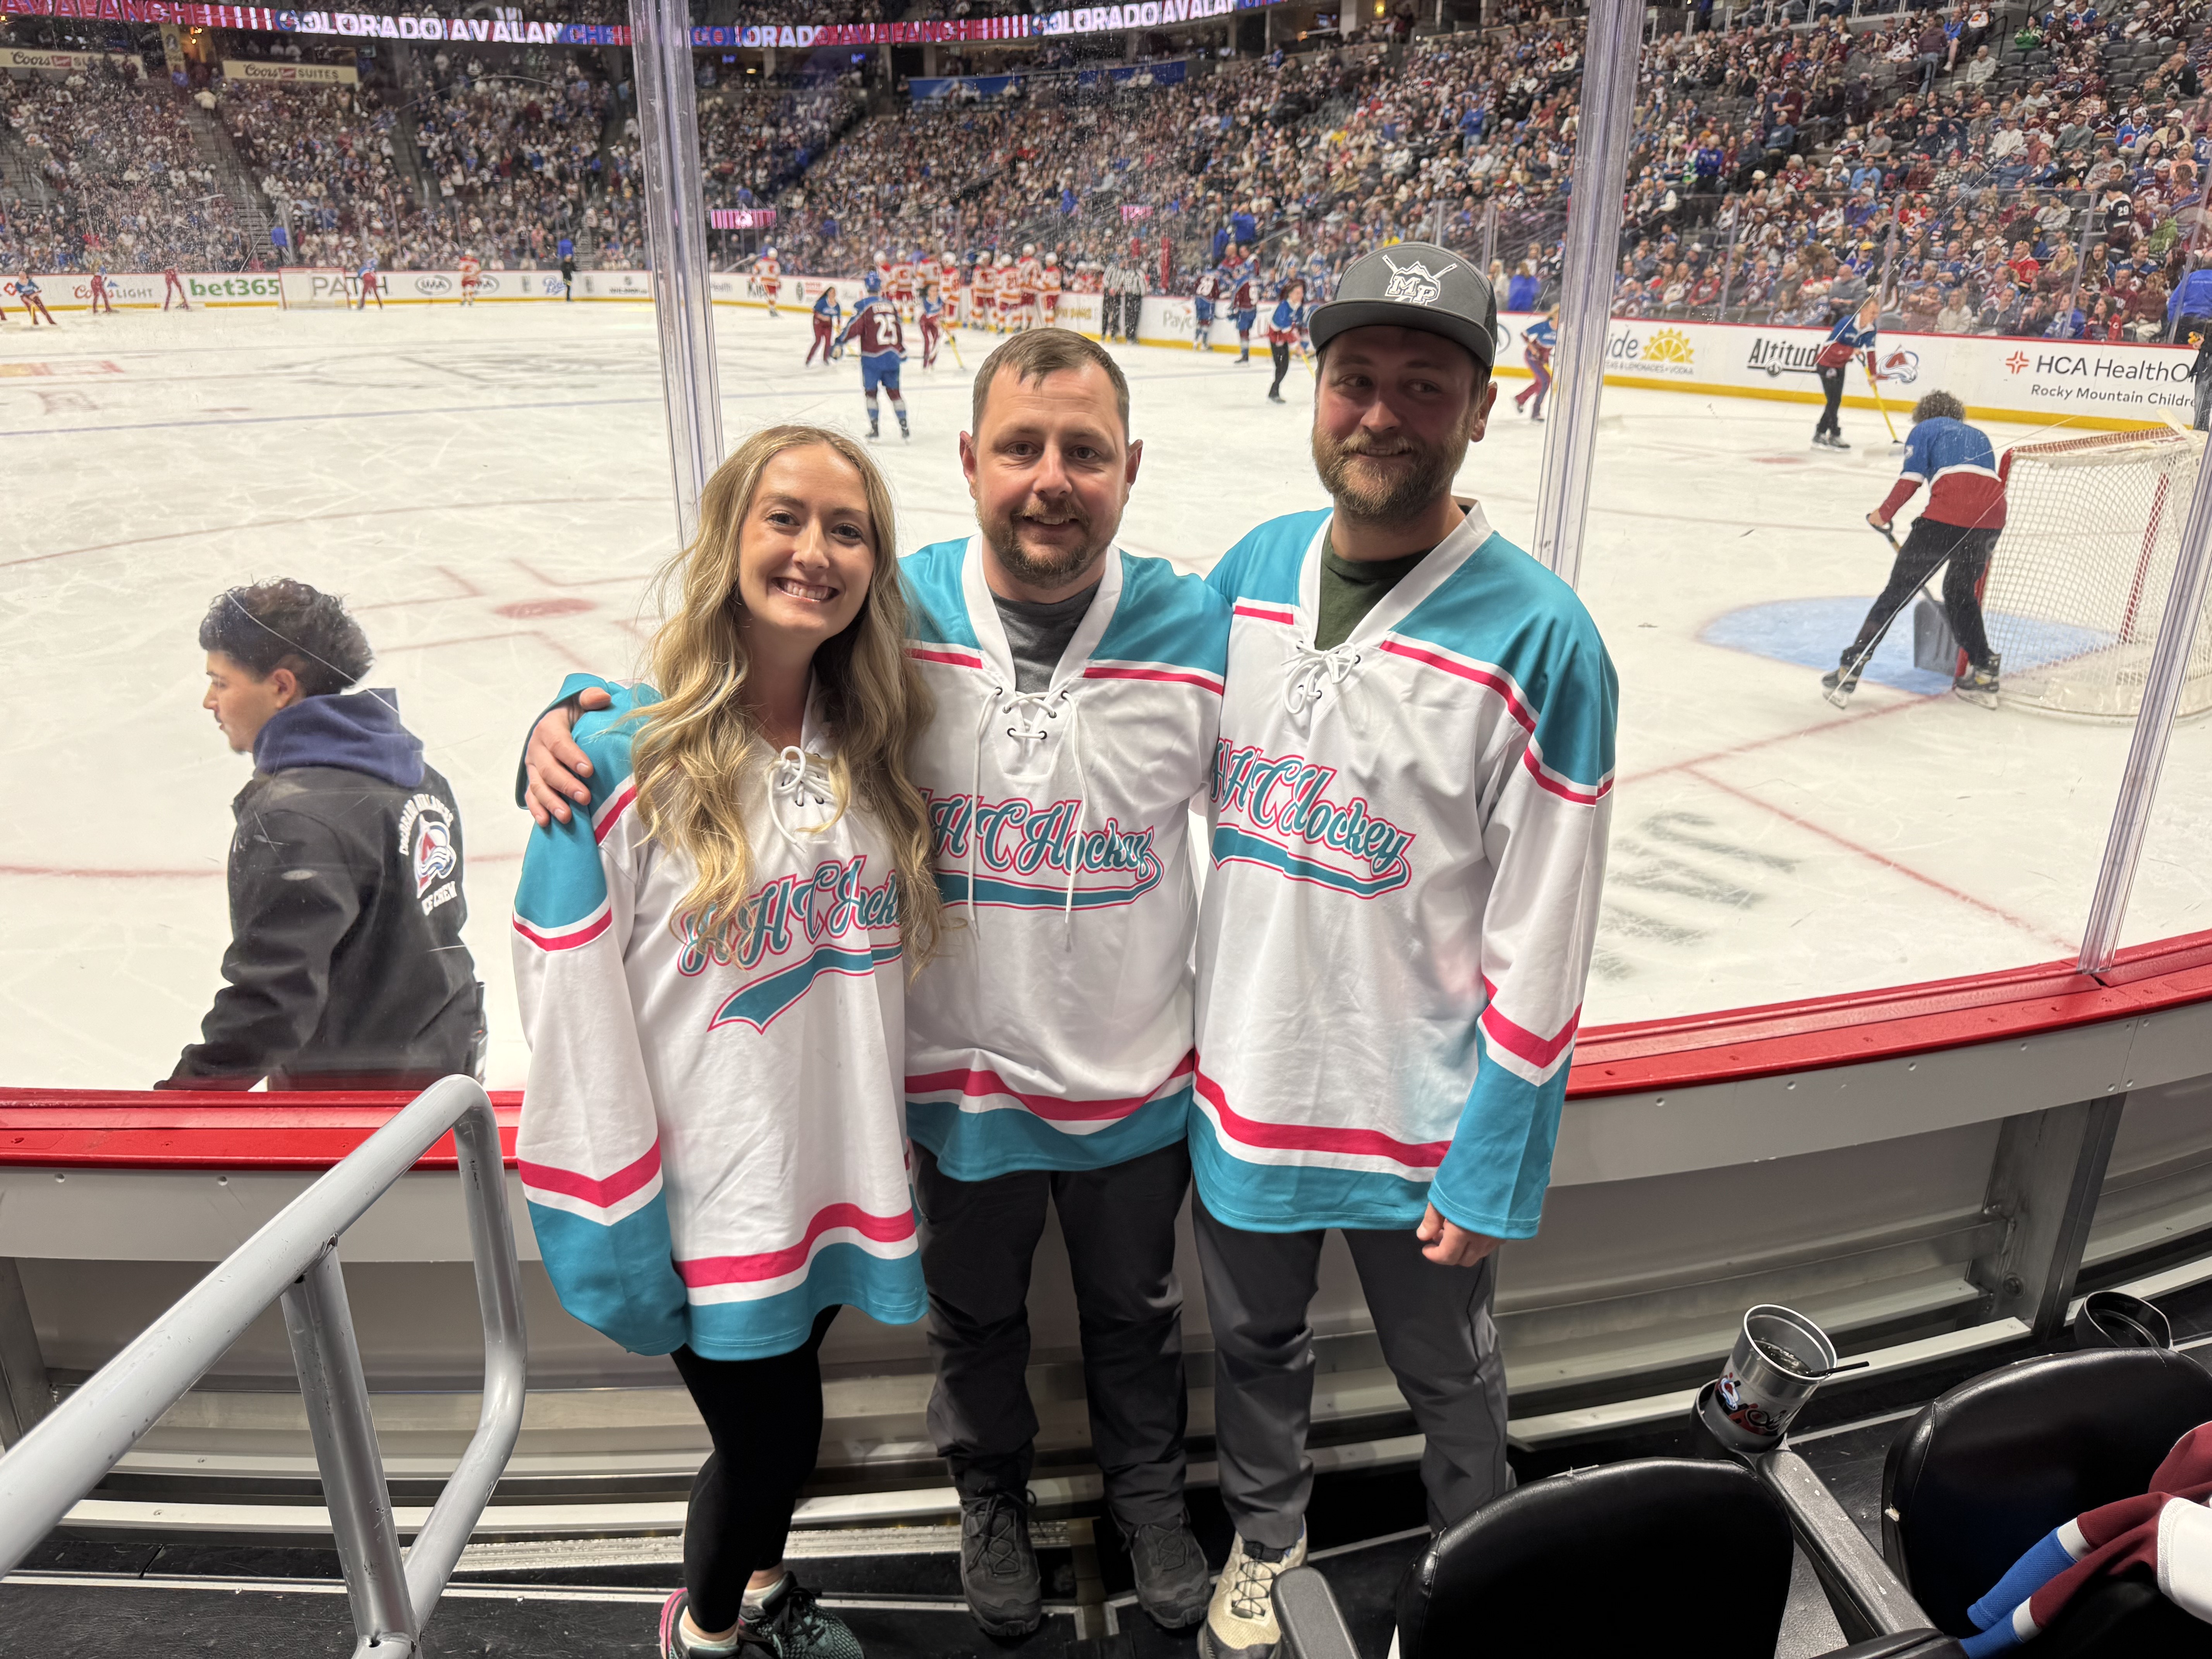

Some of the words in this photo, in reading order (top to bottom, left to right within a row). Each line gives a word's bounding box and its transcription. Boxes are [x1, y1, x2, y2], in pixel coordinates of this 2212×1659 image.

[276, 9, 443, 40] COLORADO
[450, 19, 617, 46] AVALANCHE
[12, 51, 51, 65] Coors
[245, 64, 280, 77] Coors
[298, 69, 338, 80] SUITES
[117, 289, 152, 299] LIGHT
[189, 279, 280, 296] bet365
[1388, 274, 1439, 304] MP
[874, 314, 898, 345] 25
[1606, 329, 1638, 359] ide
[1746, 338, 1821, 367] Altitud
[2036, 355, 2087, 376] HCA
[2031, 384, 2073, 400] Rocky
[2076, 387, 2143, 403] Mountain
[1014, 800, 1156, 882] Hockey
